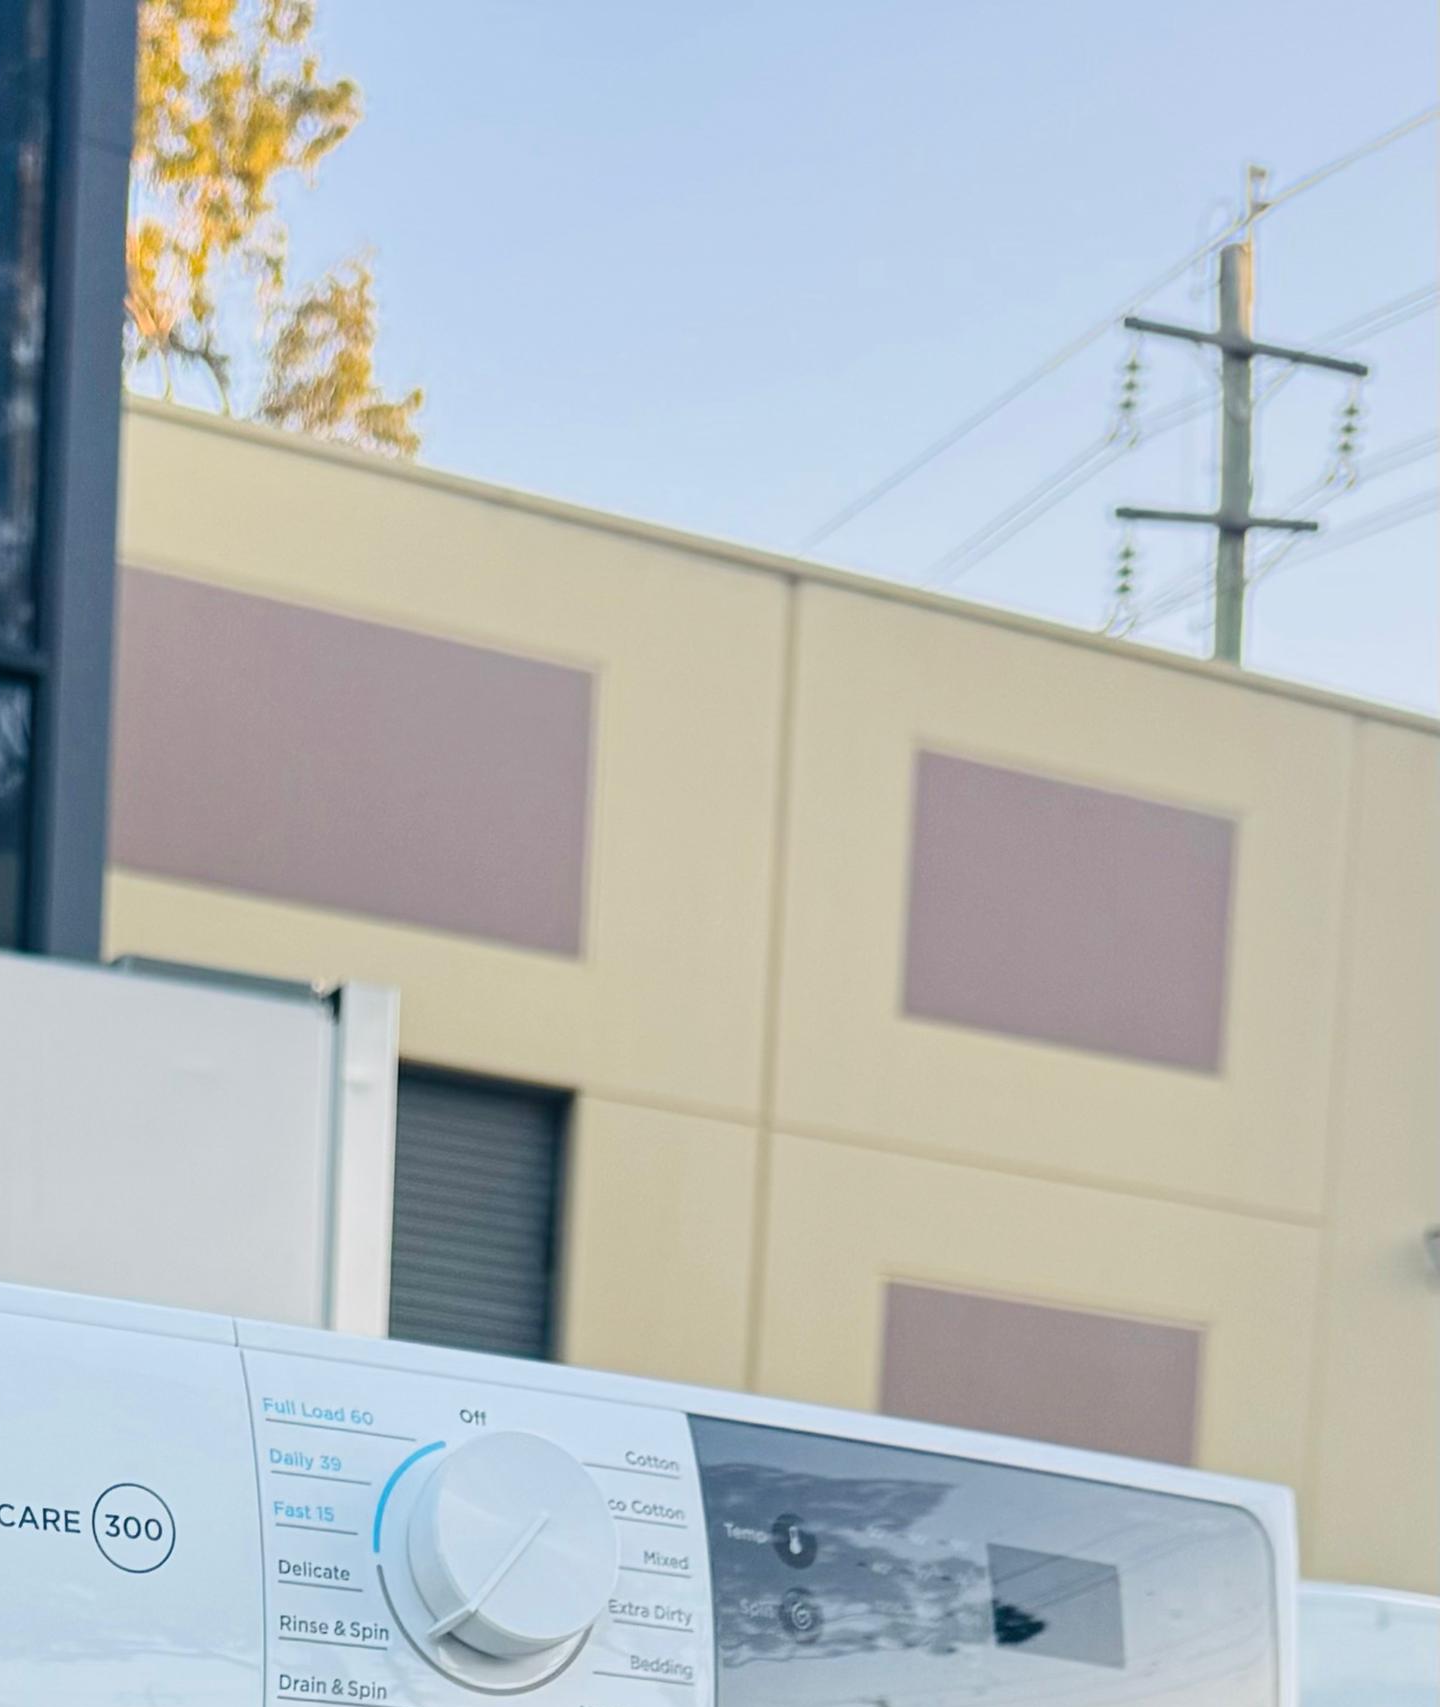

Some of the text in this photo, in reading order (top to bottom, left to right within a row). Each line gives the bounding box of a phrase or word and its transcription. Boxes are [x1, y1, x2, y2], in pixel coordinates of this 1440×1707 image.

[262, 1397, 374, 1426] Full Load 60
[459, 1408, 487, 1427] Off
[269, 1447, 342, 1472] Daily 39
[624, 1450, 680, 1472] Cotton
[273, 1500, 335, 1523] Fast 15
[607, 1498, 686, 1520] co Cotton
[104, 1513, 163, 1542] 300
[278, 1559, 351, 1582] Delicate
[643, 1550, 689, 1571] Mixed
[608, 1598, 693, 1627] Extra Dirty
[279, 1614, 390, 1642] Rinse & Spin
[629, 1654, 694, 1681] Bedding
[279, 1673, 388, 1700] Drain & Spin
